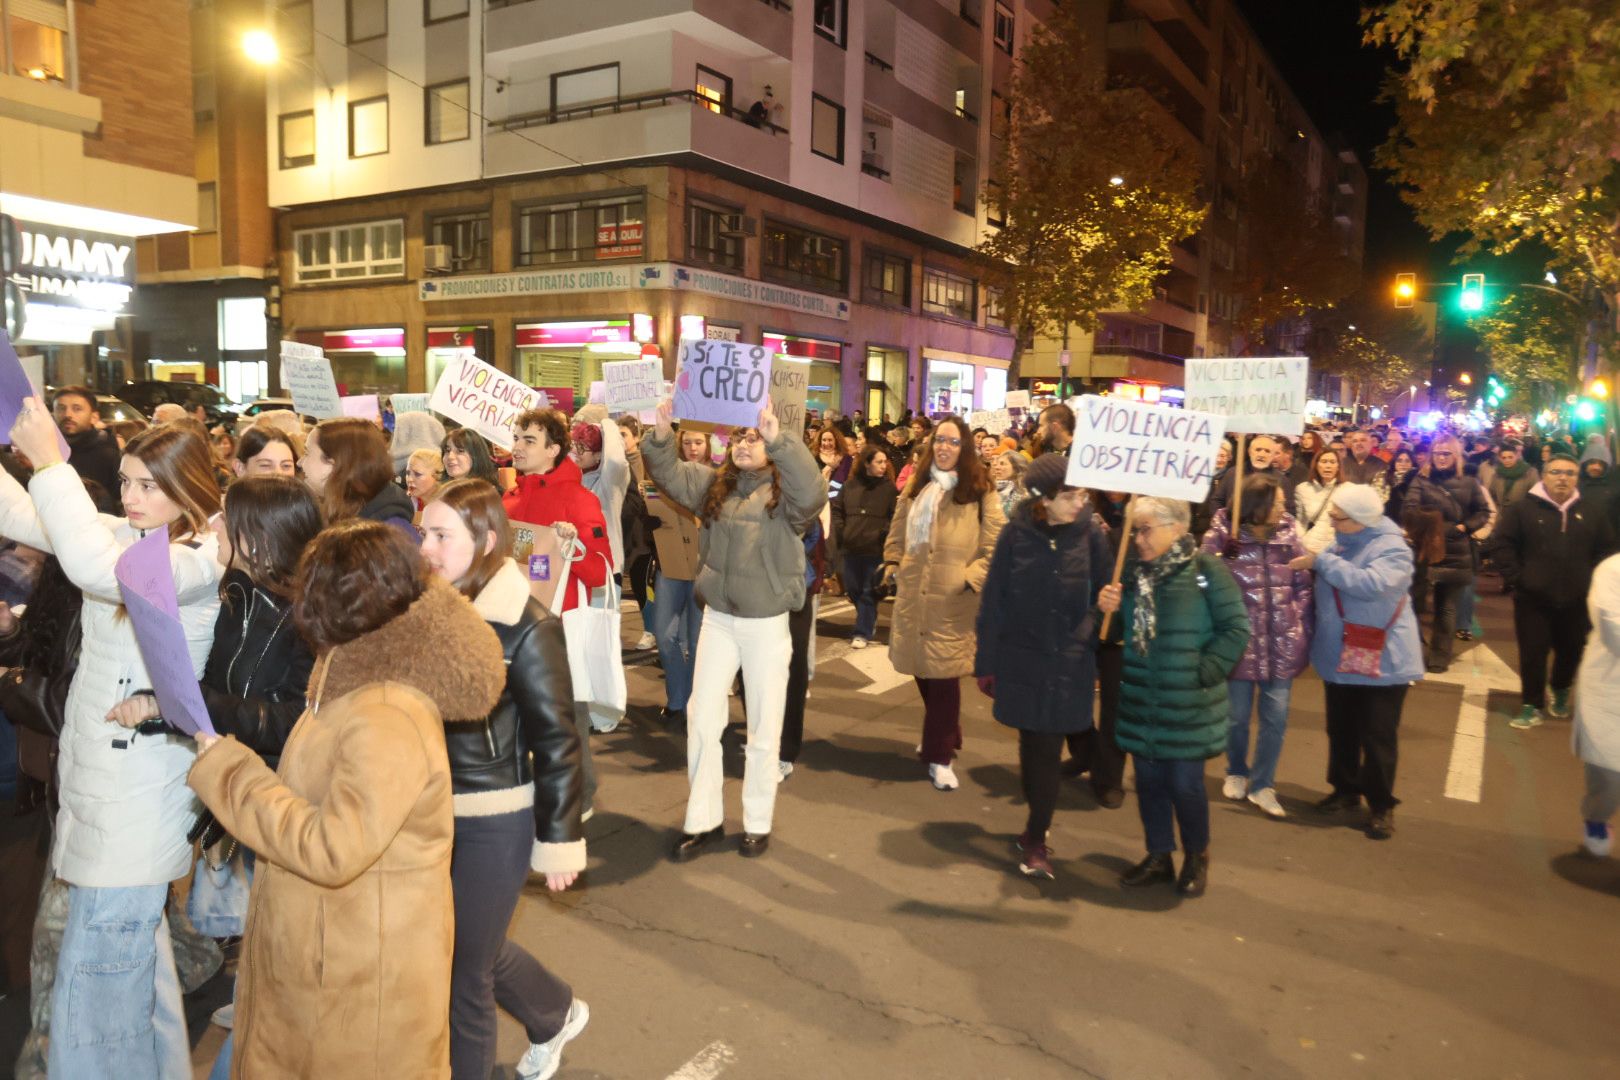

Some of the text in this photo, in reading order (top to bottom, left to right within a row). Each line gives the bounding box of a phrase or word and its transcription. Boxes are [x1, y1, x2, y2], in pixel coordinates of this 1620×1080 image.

[611, 229, 643, 241] AQUIL
[441, 278, 507, 296] PROMOCIONES
[508, 277, 516, 291] Y
[518, 273, 576, 291] CONTRATAS
[578, 271, 613, 289] CURTO
[693, 272, 752, 298] PROMOCIONES
[754, 284, 759, 298] Y
[760, 286, 801, 307] CONTRATAS
[803, 296, 825, 312] CURTO
[721, 344, 742, 366] TE
[1191, 362, 1288, 381] VIOLENCIA
[460, 360, 532, 410] VIOLENCIA
[700, 366, 765, 403] CREO
[1191, 389, 1301, 415] PATRIMONIAL
[449, 384, 515, 431] VICARIA
[1089, 403, 1212, 445] VIOLENCIA
[1079, 442, 1215, 485] OBSTÉTRICA
